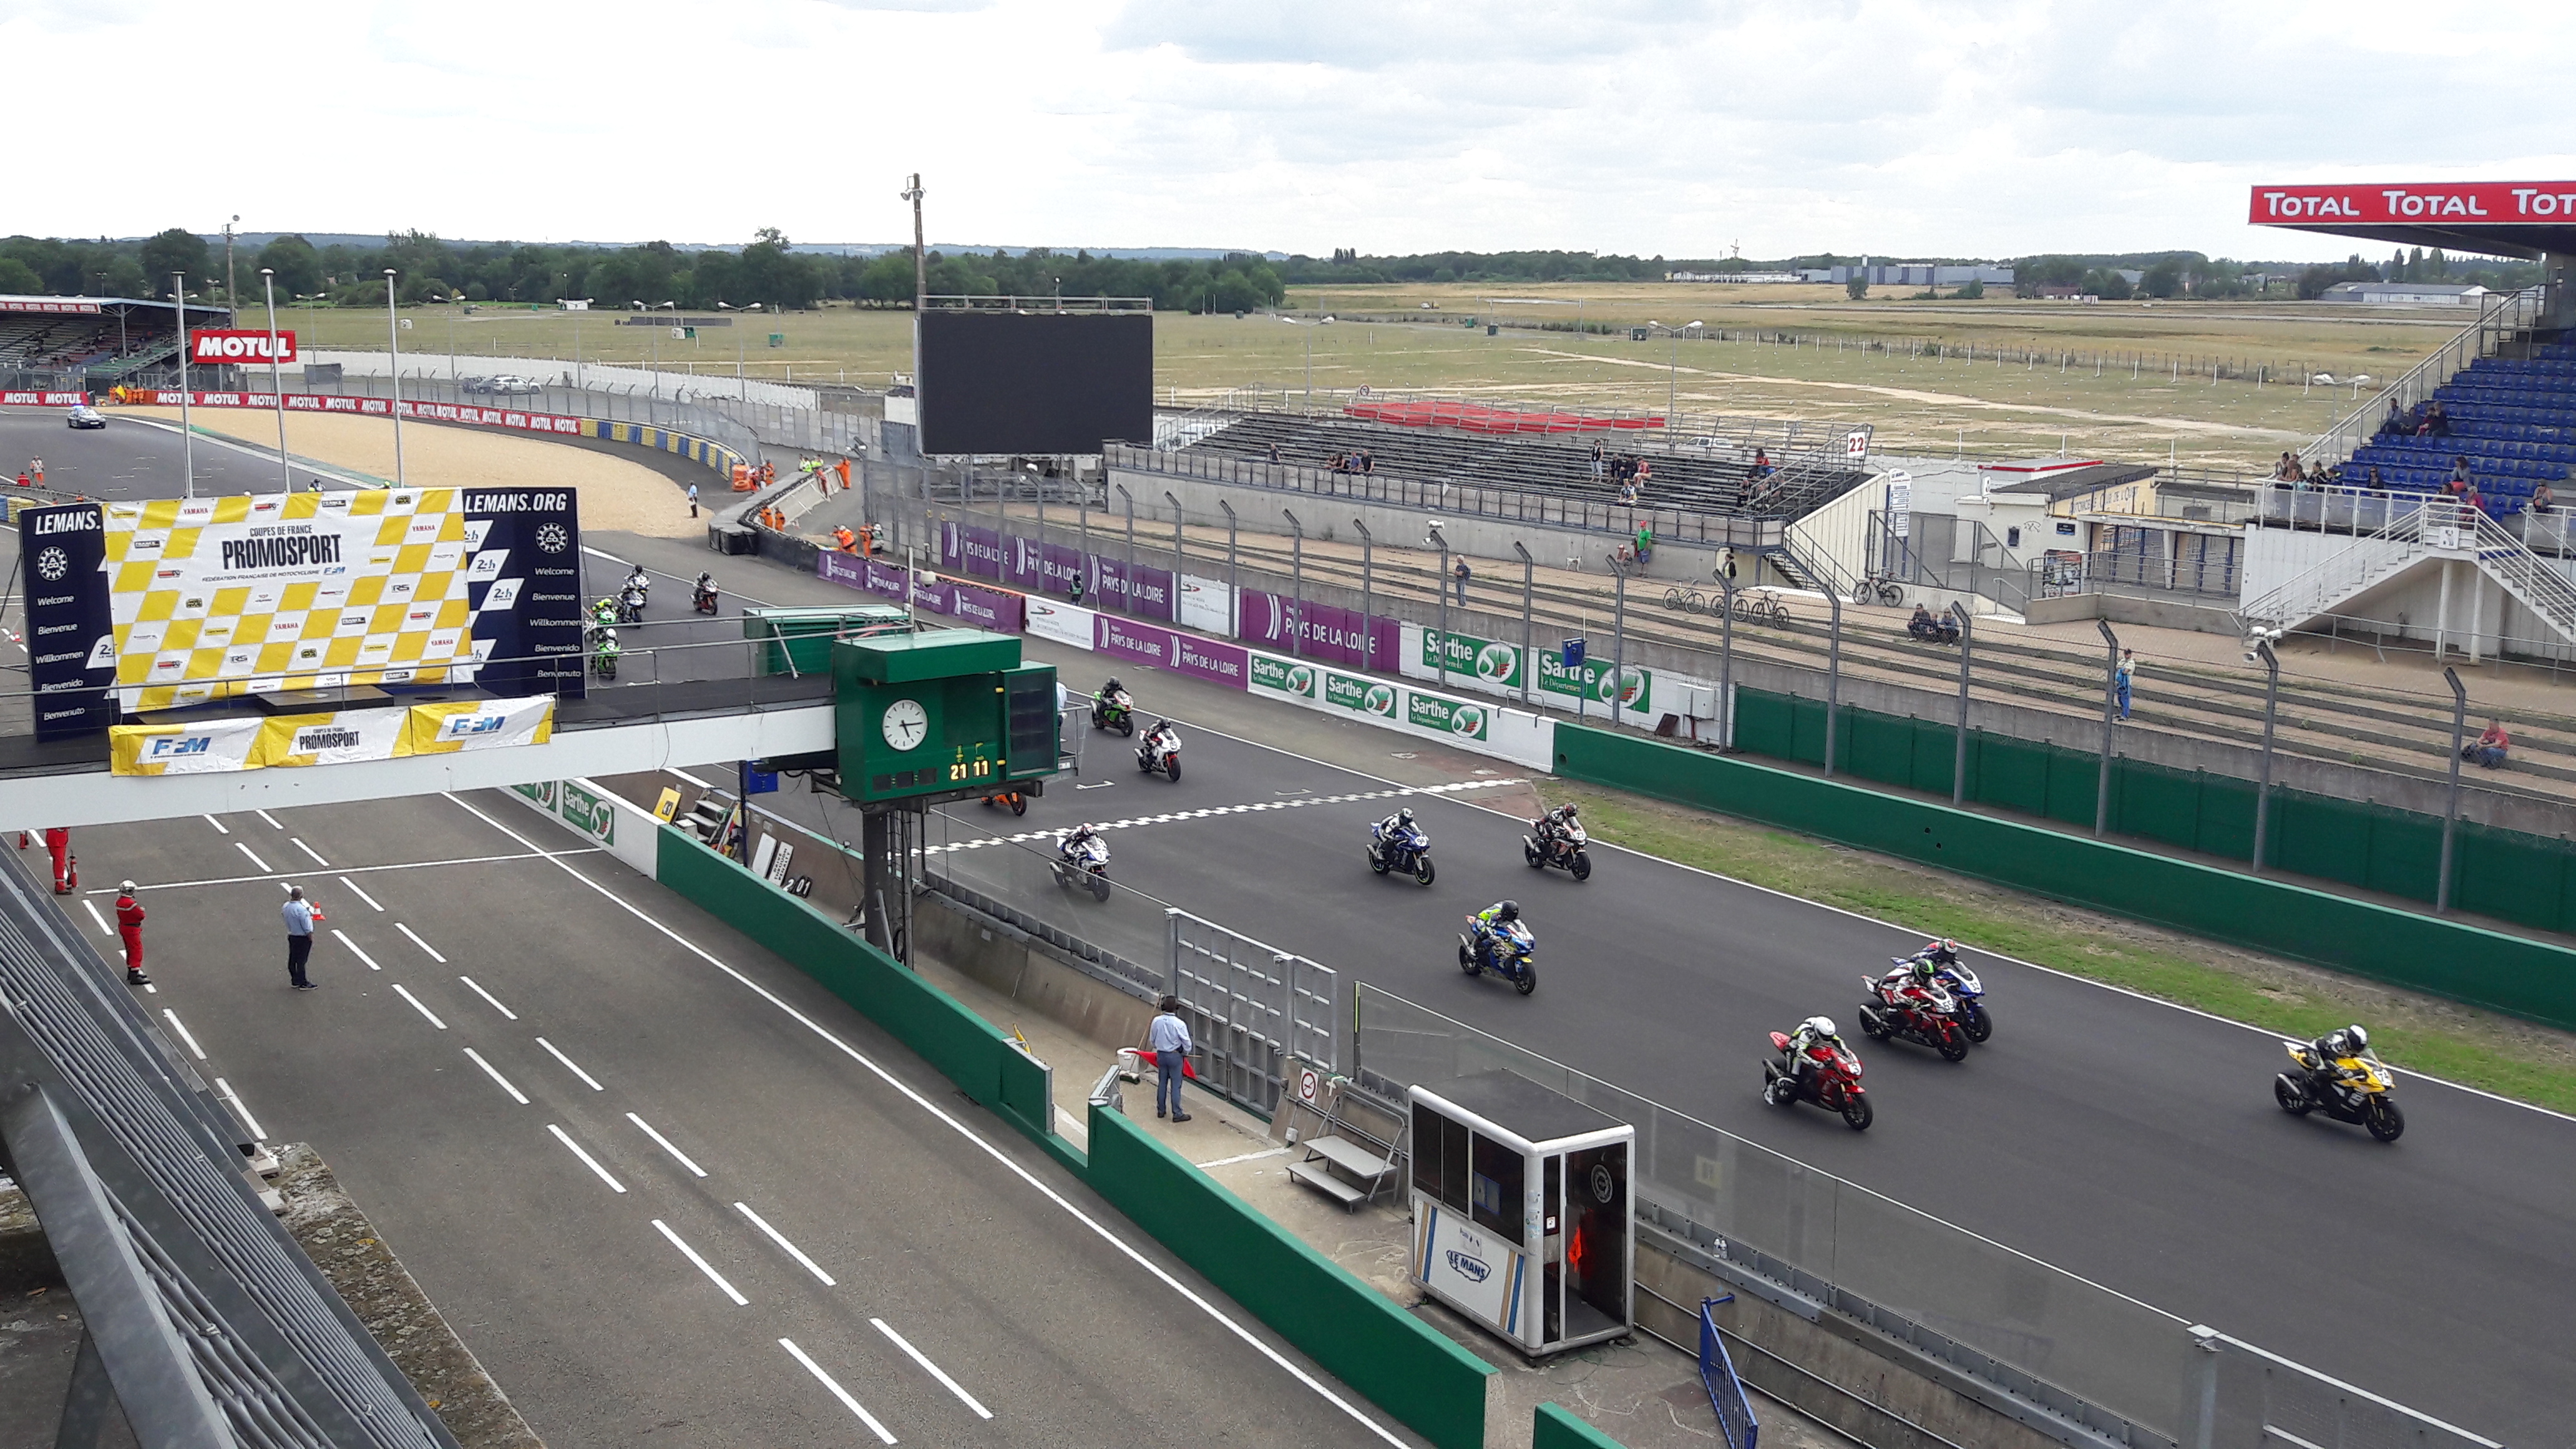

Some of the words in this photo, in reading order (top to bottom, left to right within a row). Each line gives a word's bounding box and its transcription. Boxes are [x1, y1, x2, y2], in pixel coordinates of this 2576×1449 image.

[2263, 192, 2359, 217] TOTAL
[2383, 190, 2487, 216] TOTAL
[197, 337, 291, 358] MOTUL
[4, 393, 39, 404] MOTUL
[45, 393, 82, 404] MOTUL
[203, 393, 240, 405] MOTUL
[247, 394, 277, 406] MOTU
[288, 396, 320, 408] MOTUL
[325, 398, 356, 410] MOTUL
[362, 400, 386, 412] MOTUL
[505, 413, 527, 427] MOTUL
[531, 416, 552, 431] MOTUL
[554, 419, 577, 432] MOTUL
[1849, 437, 1864, 452] 22
[465, 493, 567, 513] LEMANS.ORG
[250, 526, 275, 537] COUPES
[278, 525, 285, 535] DE
[288, 525, 313, 534] FRANCE
[222, 534, 341, 570] PROMOSPORT
[1027, 555, 1039, 571] PAY
[535, 567, 575, 576] Welcome
[1102, 574, 1120, 592] PAYS
[1132, 581, 1142, 598] LA
[1143, 584, 1164, 604] LOIRE
[37, 595, 75, 606] Welcome
[532, 593, 575, 601] Bienvenue
[37, 623, 78, 635] Bienvenue
[530, 618, 582, 627] Willkommen
[1111, 633, 1126, 648] PAYS
[1126, 636, 1134, 650] DE
[1135, 639, 1143, 652] LA
[1144, 642, 1162, 657] LOIRE
[1313, 623, 1327, 643] DE
[1329, 627, 1342, 646] LA
[1345, 630, 1376, 654] LOIE
[534, 643, 580, 652] Bienvenido
[35, 651, 84, 665] Willkommen
[1183, 651, 1199, 667] PAYS
[1199, 655, 1209, 670] DE
[1209, 658, 1218, 672] LA
[1219, 660, 1239, 677] LOIRE
[1253, 658, 1284, 680] Sarthe
[41, 678, 84, 692] Bienvenido
[1329, 675, 1362, 699] Sarthe
[44, 707, 85, 721] Benvenuto
[1412, 695, 1449, 720] Sarthe
[299, 731, 360, 751] PROMOSPORT
[950, 763, 967, 780] 21
[973, 760, 988, 776] 11
[565, 784, 590, 817] Sarthe
[1450, 1251, 1459, 1265] LE
[1461, 1257, 1485, 1279] MANS
